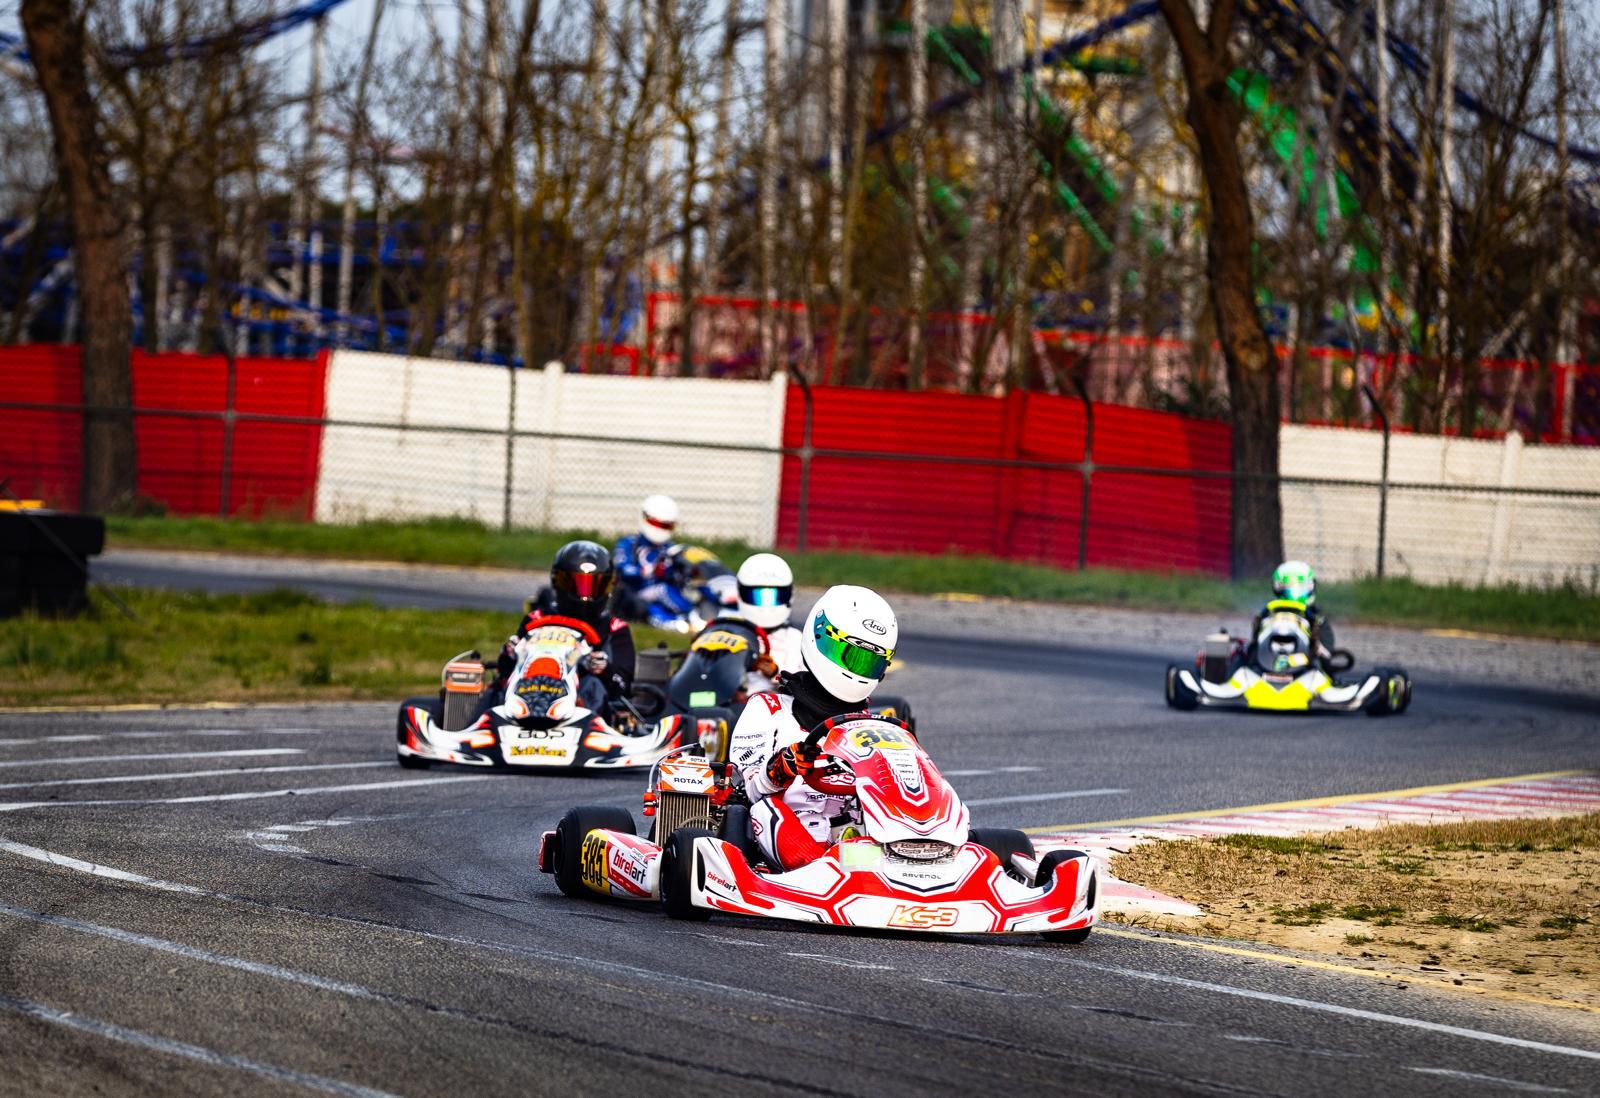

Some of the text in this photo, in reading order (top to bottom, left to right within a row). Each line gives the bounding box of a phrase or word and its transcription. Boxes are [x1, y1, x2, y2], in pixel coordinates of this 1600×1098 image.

[673, 777, 704, 785] ROTAX
[580, 834, 607, 888] 385
[613, 848, 647, 885] birelart
[707, 871, 737, 892] birelart
[902, 872, 942, 880] RAVENOL
[887, 904, 960, 929] KS3
